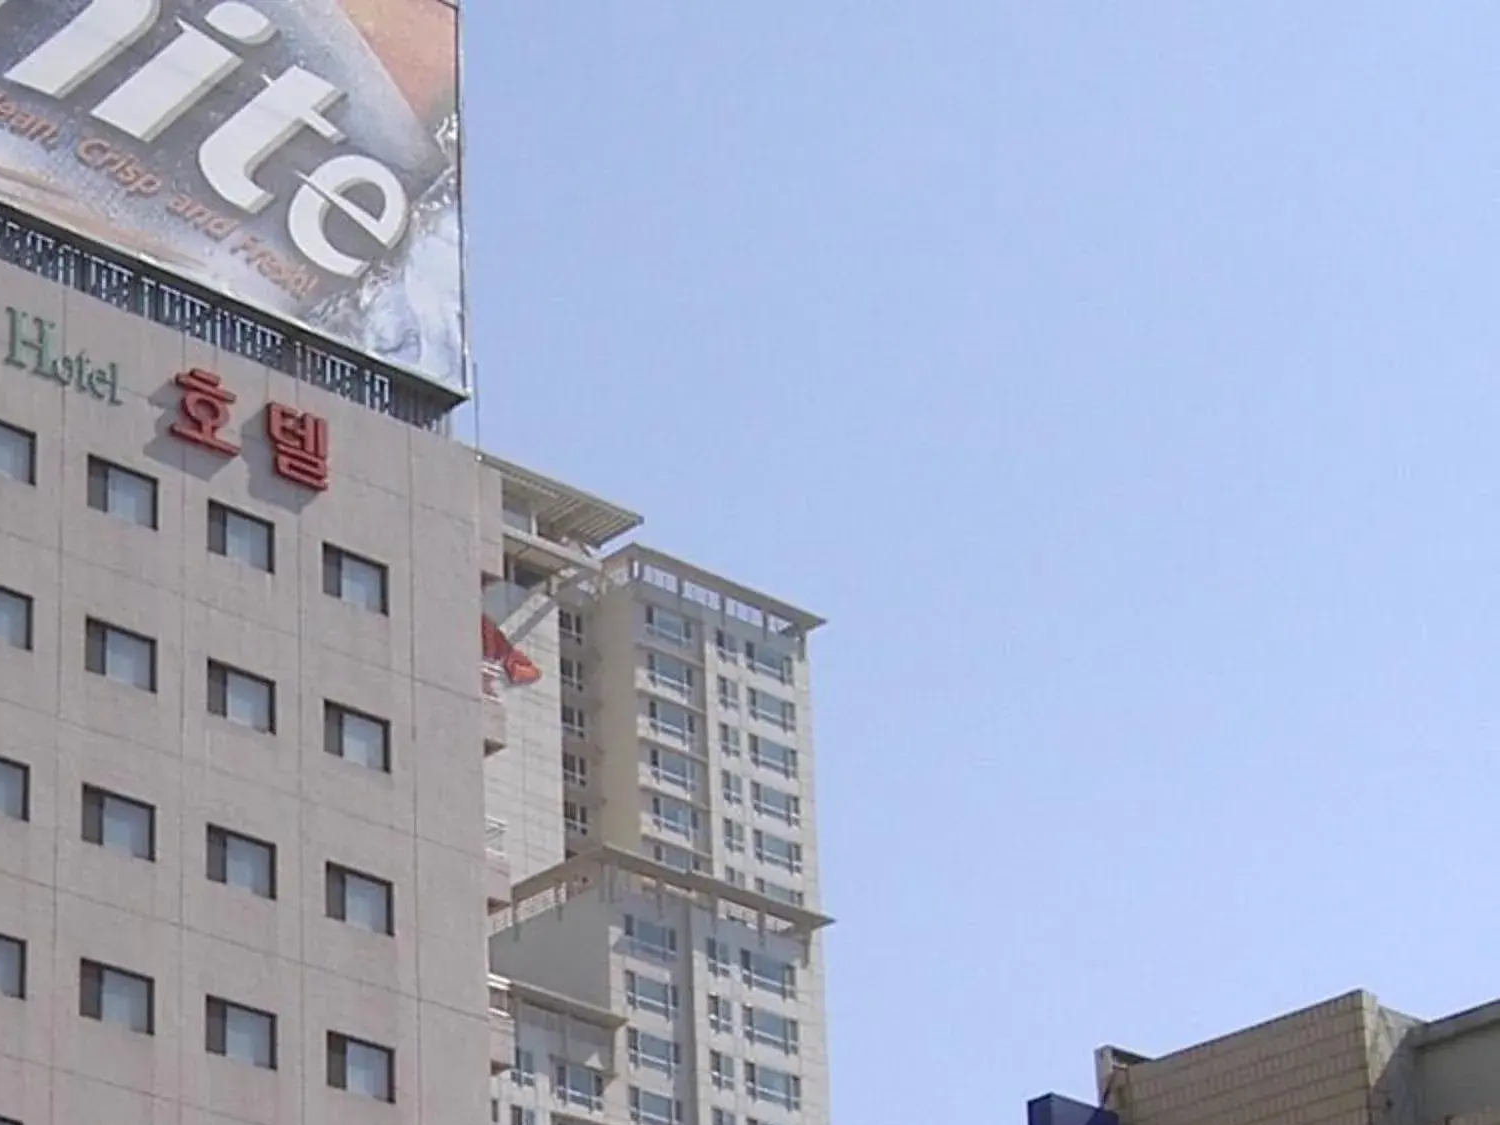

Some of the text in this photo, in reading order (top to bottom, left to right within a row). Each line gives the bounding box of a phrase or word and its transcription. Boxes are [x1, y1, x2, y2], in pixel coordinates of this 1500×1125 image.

[78, 137, 161, 194] Crisp
[168, 193, 239, 237] and
[3, 306, 124, 406] Hotel
[170, 368, 329, 490] 호텔
